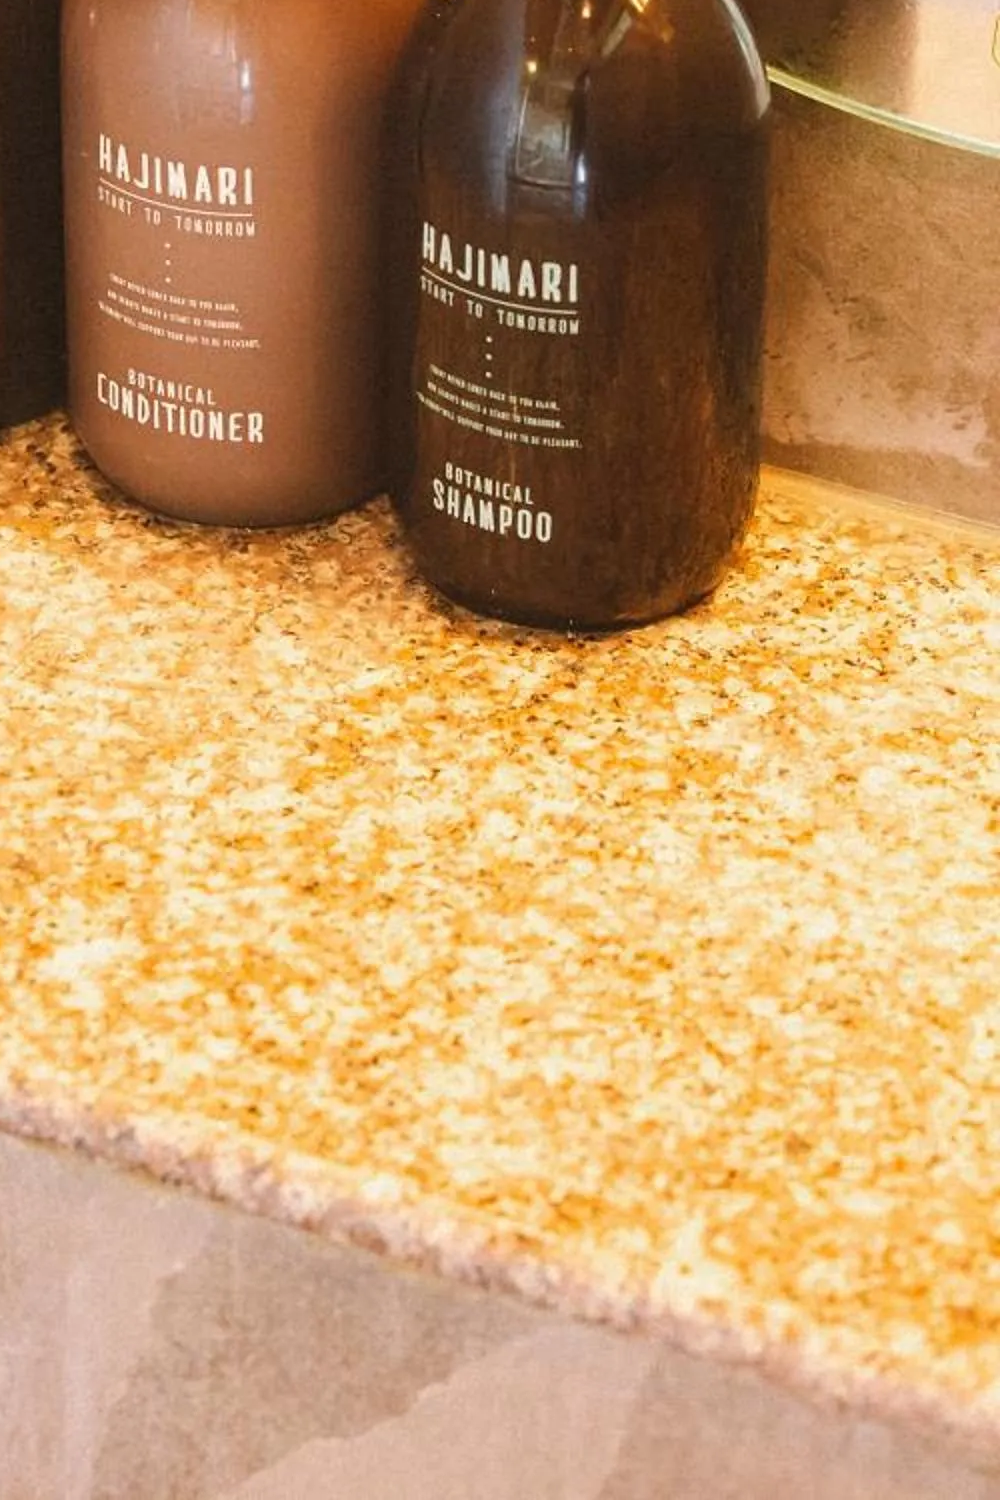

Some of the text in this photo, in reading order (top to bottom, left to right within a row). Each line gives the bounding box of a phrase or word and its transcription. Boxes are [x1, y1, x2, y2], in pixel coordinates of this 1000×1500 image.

[100, 133, 253, 206] HAJIMARI
[98, 186, 255, 237] START TO TOMORROW
[423, 221, 578, 303] HAJIMARI
[420, 275, 579, 335] START TO TOMORROW
[97, 372, 264, 443] CONDITIONER
[127, 368, 217, 406] BOTANICAL
[433, 478, 552, 543] SHAMPOO
[445, 461, 535, 505] BOTANICAL
